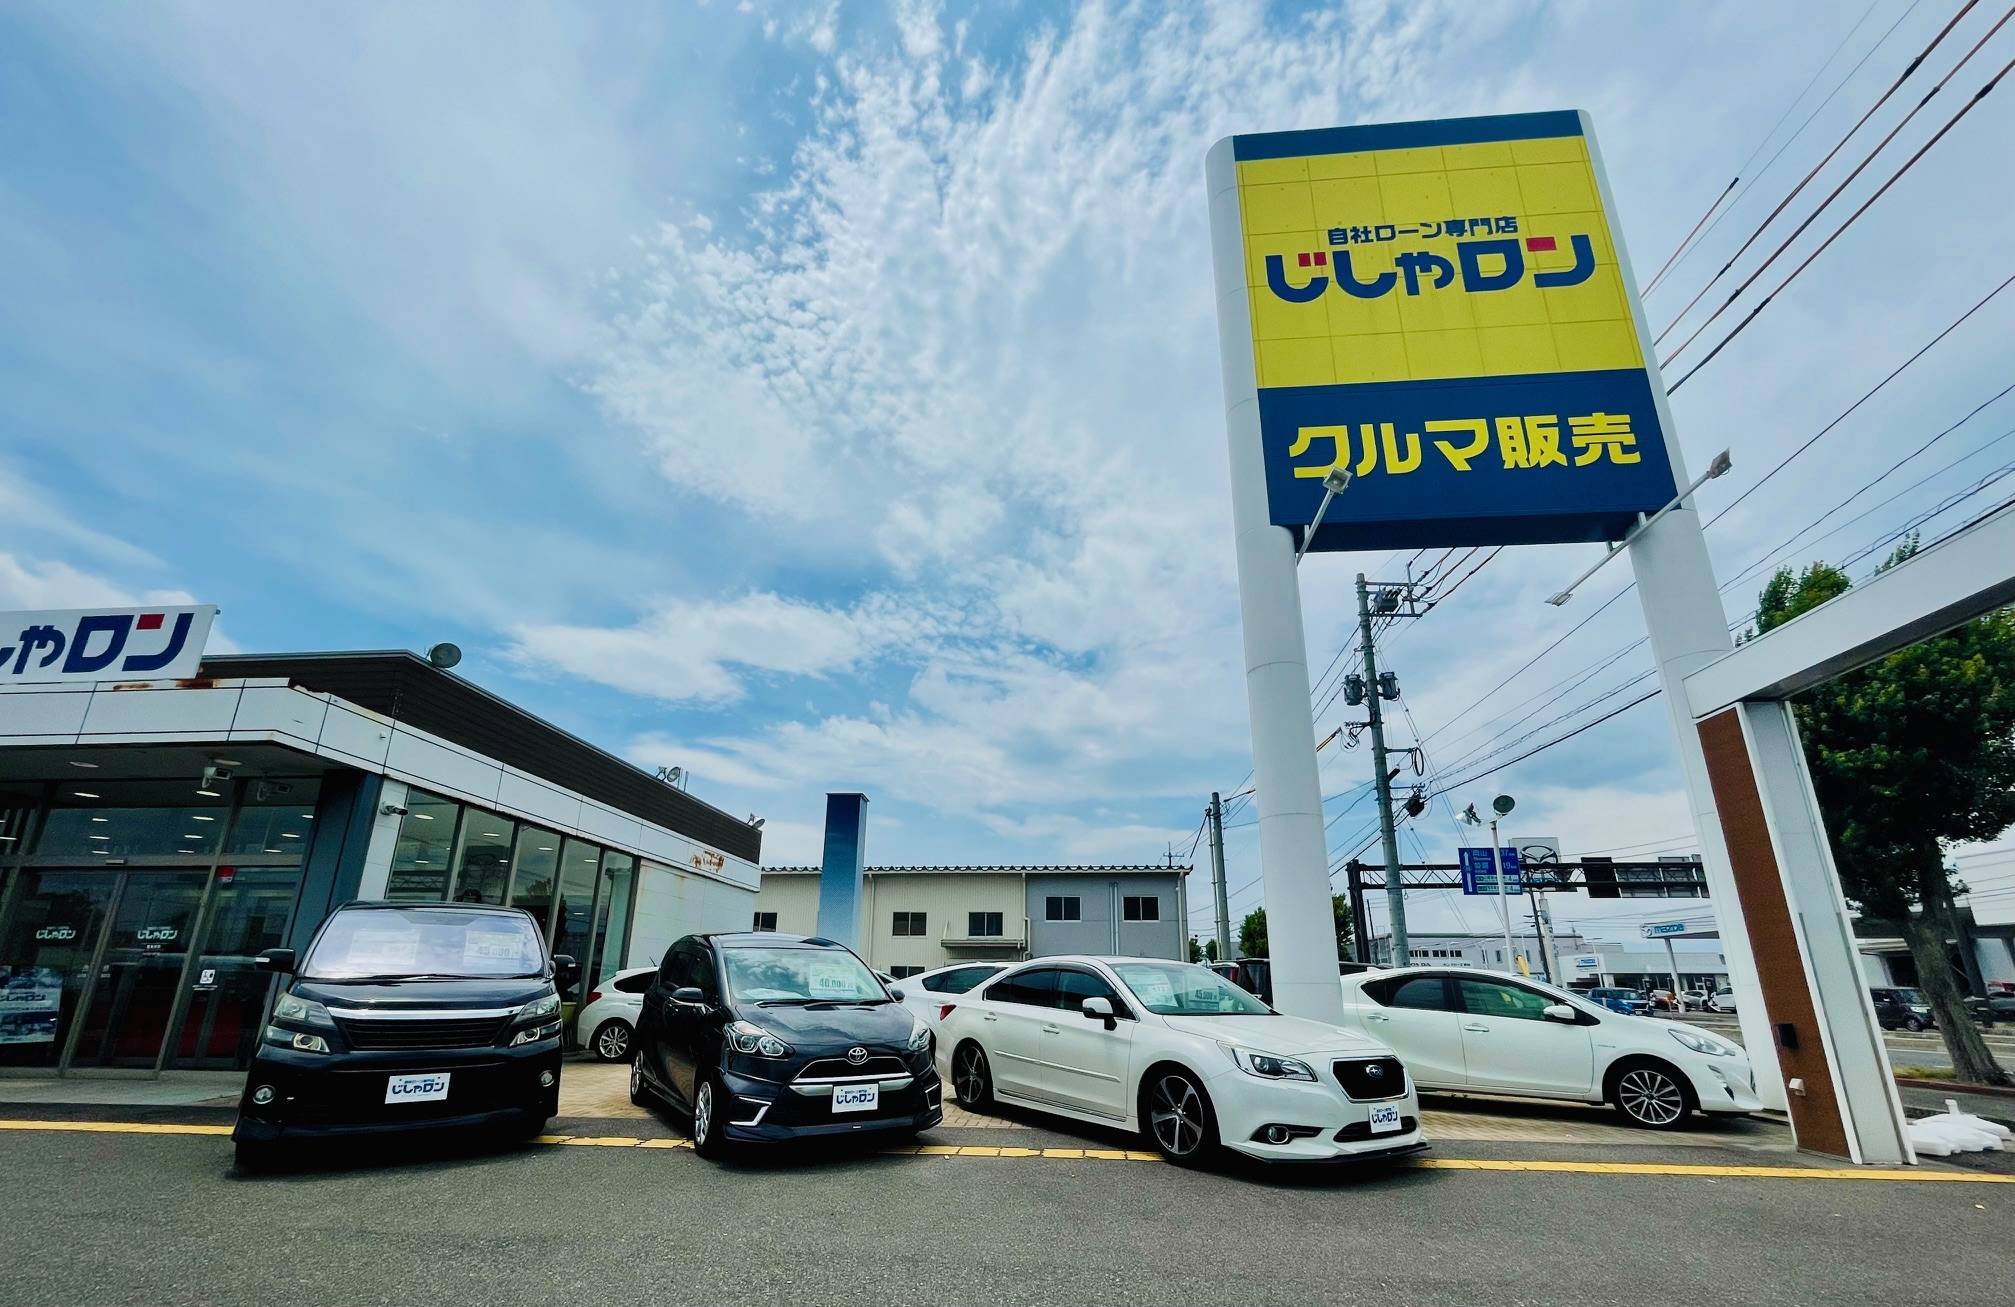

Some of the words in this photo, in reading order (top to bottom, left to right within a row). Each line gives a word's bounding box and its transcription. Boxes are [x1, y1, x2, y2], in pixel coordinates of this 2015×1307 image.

[1328, 216, 1518, 245] 自社ローン専門店
[1265, 233, 1596, 303] じしゃロン
[1288, 411, 1642, 480] クルマ販売
[391, 1082, 445, 1095] じしゃロン
[836, 1092, 875, 1105] じしゃロン
